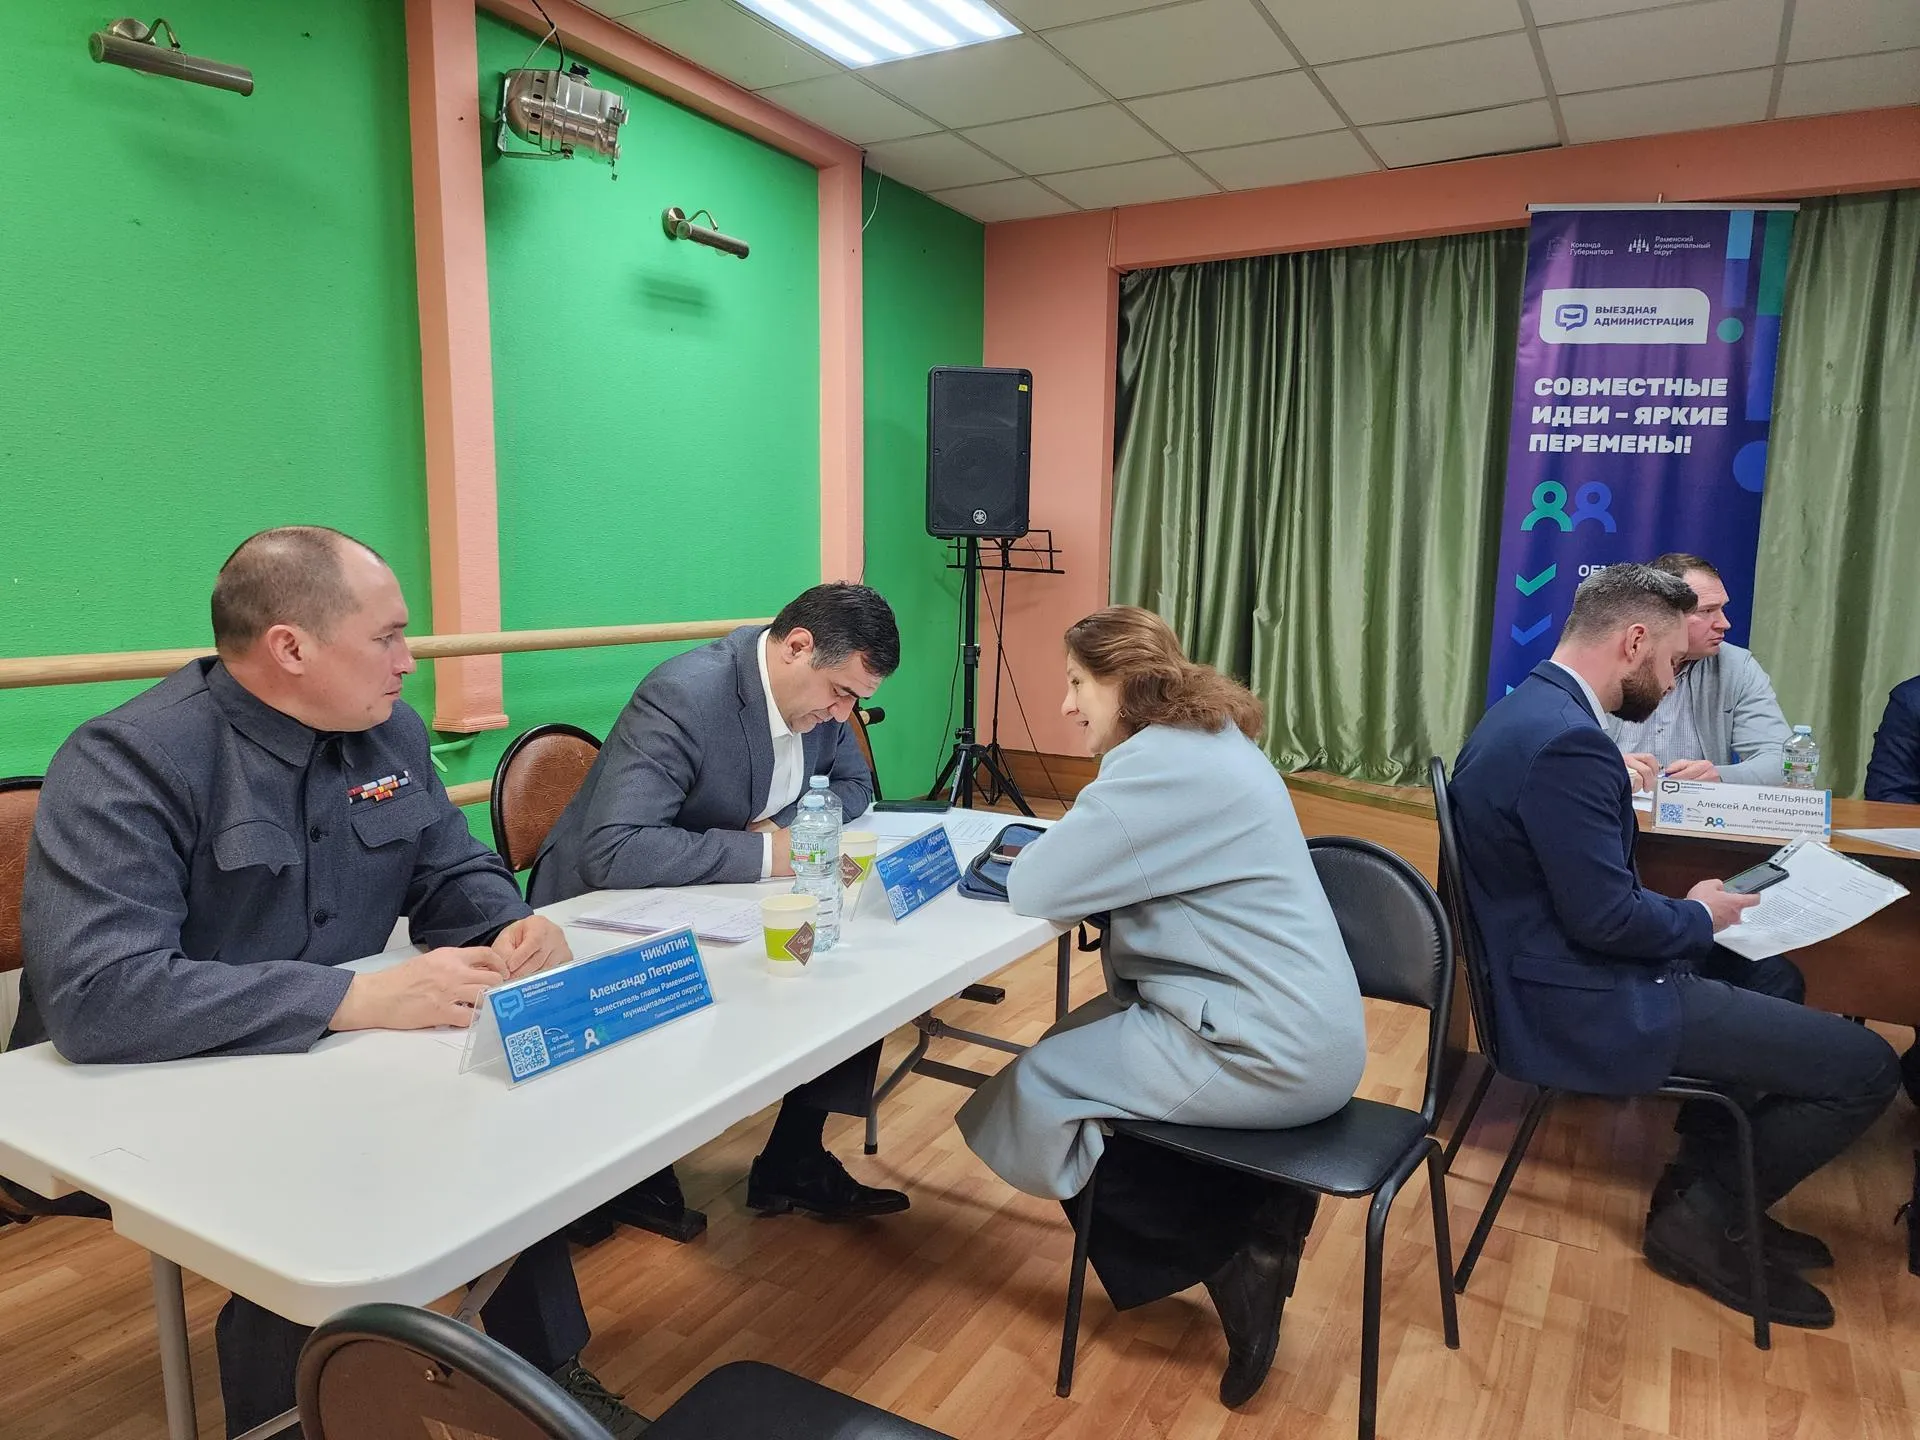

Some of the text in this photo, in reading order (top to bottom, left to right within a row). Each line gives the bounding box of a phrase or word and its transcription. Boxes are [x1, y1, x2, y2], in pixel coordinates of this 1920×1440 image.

[1570, 241, 1601, 249] Команда
[1654, 241, 1711, 250] муниципальный
[1655, 235, 1694, 243] Раменский
[1569, 248, 1614, 256] Губернатора
[1654, 248, 1673, 257] округ
[1595, 306, 1657, 315] ВЫЕЗДНАЯ
[1594, 317, 1694, 327] АДМИНИСТРАЦИЯ
[1534, 378, 1728, 397] СОВМЕСТНЫЕ
[1531, 406, 1610, 427] ИДЕИ
[1632, 407, 1728, 426] ЯРКИЕ
[1529, 434, 1692, 454] ПЕРЕМЕНЫ!
[1758, 793, 1824, 805] ЕМЕЛЬЯНОВ
[1697, 800, 1824, 817] Алексей Александрович
[640, 936, 690, 962] НИКИТИН
[589, 955, 695, 1001] Александр Петрович
[593, 993, 640, 1016] Заместитель
[639, 986, 661, 1000] главы
[660, 971, 700, 991] Раменского
[622, 991, 681, 1020] муниципального
[681, 982, 703, 998] округа
